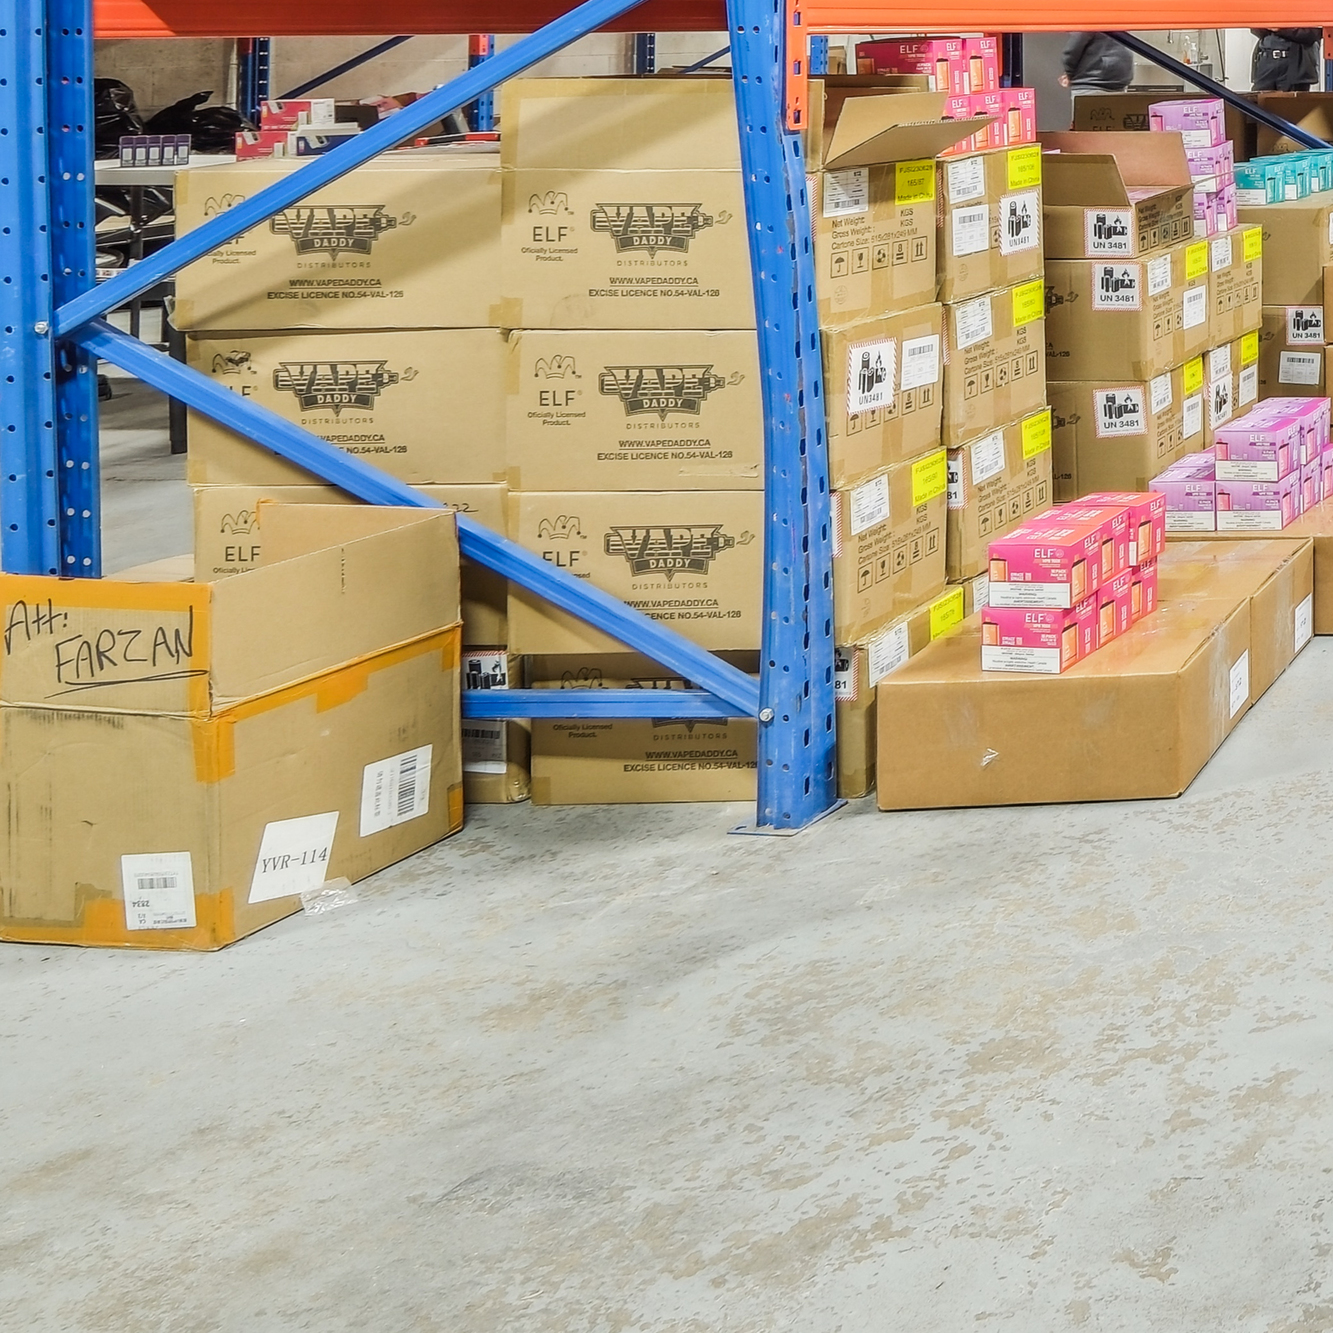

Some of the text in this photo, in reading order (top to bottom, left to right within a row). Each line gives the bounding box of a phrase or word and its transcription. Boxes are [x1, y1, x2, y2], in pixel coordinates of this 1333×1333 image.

[900, 45, 918, 53] ELF
[946, 42, 957, 51] ELF
[980, 40, 990, 49] ELF
[985, 95, 996, 105] ELF
[1018, 92, 1029, 100] ELF
[952, 99, 963, 108] ELF
[900, 208, 913, 216] KGS
[284, 208, 376, 237] VAPE
[603, 205, 694, 235] VAPE
[832, 219, 842, 228] Net
[900, 219, 913, 227] KGS
[532, 226, 568, 242] ELF
[832, 230, 849, 239] Gross
[314, 238, 354, 247] DADDY
[633, 236, 672, 245] DADDY
[832, 239, 854, 250] Cartone
[1093, 241, 1127, 249] UN 3481
[289, 278, 381, 287] WWW.VAPEDADDY.CA
[609, 277, 698, 285] WWW.VAPEDADDY.CA
[267, 291, 299, 299] EXCISE
[301, 291, 339, 299] LICENCE
[588, 289, 619, 297] EXCISE
[621, 289, 658, 297] LICENCE
[1115, 294, 1135, 303] 3481
[286, 364, 376, 393] VAPE
[612, 368, 702, 397] VAPE
[317, 394, 357, 403] DADDY
[539, 390, 575, 407] ELF
[643, 398, 684, 408] DADDY
[1104, 420, 1139, 429] UN 3481
[1250, 434, 1265, 442] ELF
[619, 439, 711, 448] WWW.VAPEDADDY.CA
[597, 453, 629, 461] EXCISE
[631, 452, 668, 460] LICENCE
[1186, 484, 1201, 492] ELF
[1253, 484, 1268, 492] ELF
[916, 504, 927, 514] KGS
[1150, 500, 1160, 510] ELF
[619, 528, 712, 558] VAPE
[1084, 535, 1096, 548] ELF
[225, 546, 261, 562] ELF
[1034, 549, 1053, 558] ELF
[650, 559, 691, 568] DADDY
[1113, 577, 1125, 590] ELF
[1075, 600, 1087, 613] ELF
[1025, 613, 1044, 623] ELF
[55, 605, 193, 683] FARZAN
[653, 733, 727, 741] DISTRIBUTORS
[645, 749, 738, 759] WWW.VAPEDADDY.CA
[623, 762, 695, 772] EXCISE LICENCE
[262, 847, 328, 873] YVR-114
